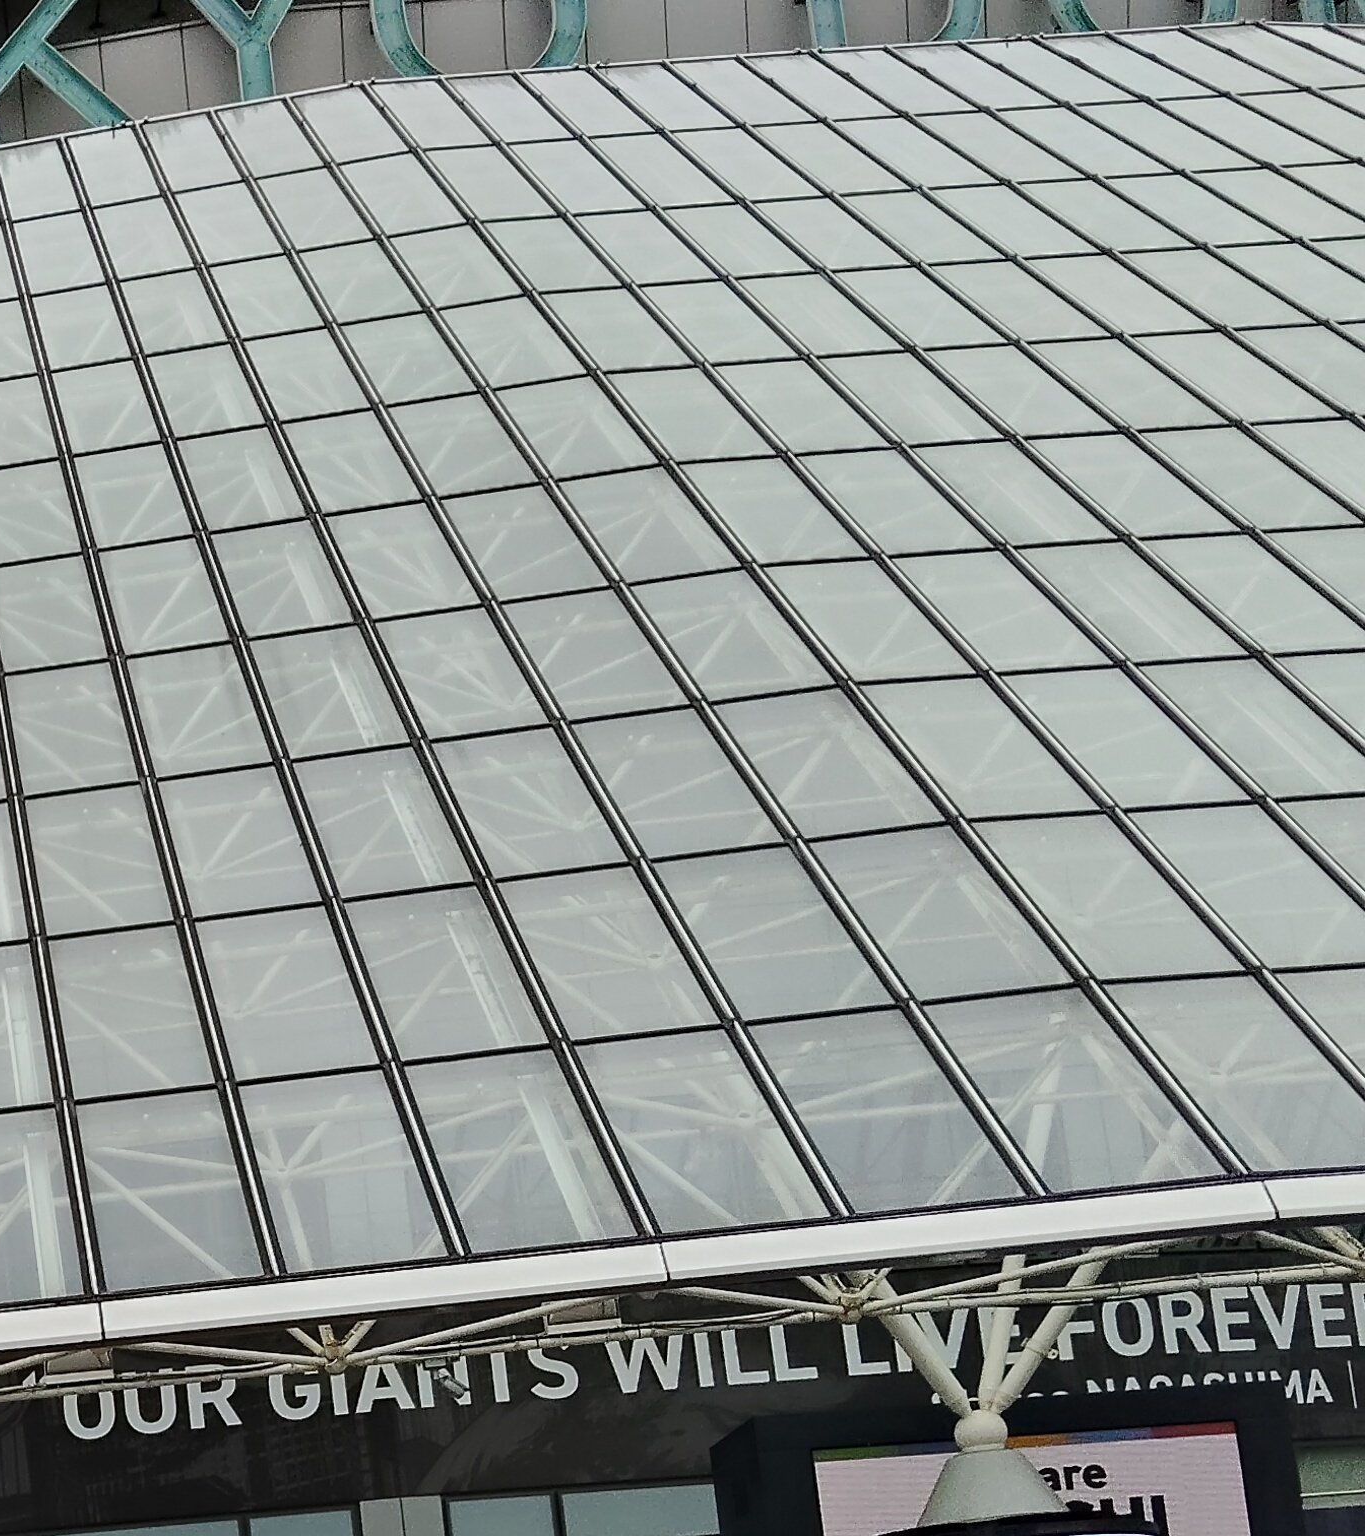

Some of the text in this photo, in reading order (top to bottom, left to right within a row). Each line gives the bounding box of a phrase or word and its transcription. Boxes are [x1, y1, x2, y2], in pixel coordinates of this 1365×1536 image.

[64, 1366, 243, 1440] OUR
[268, 1346, 579, 1421] GIANTS
[606, 1322, 819, 1395] WILL
